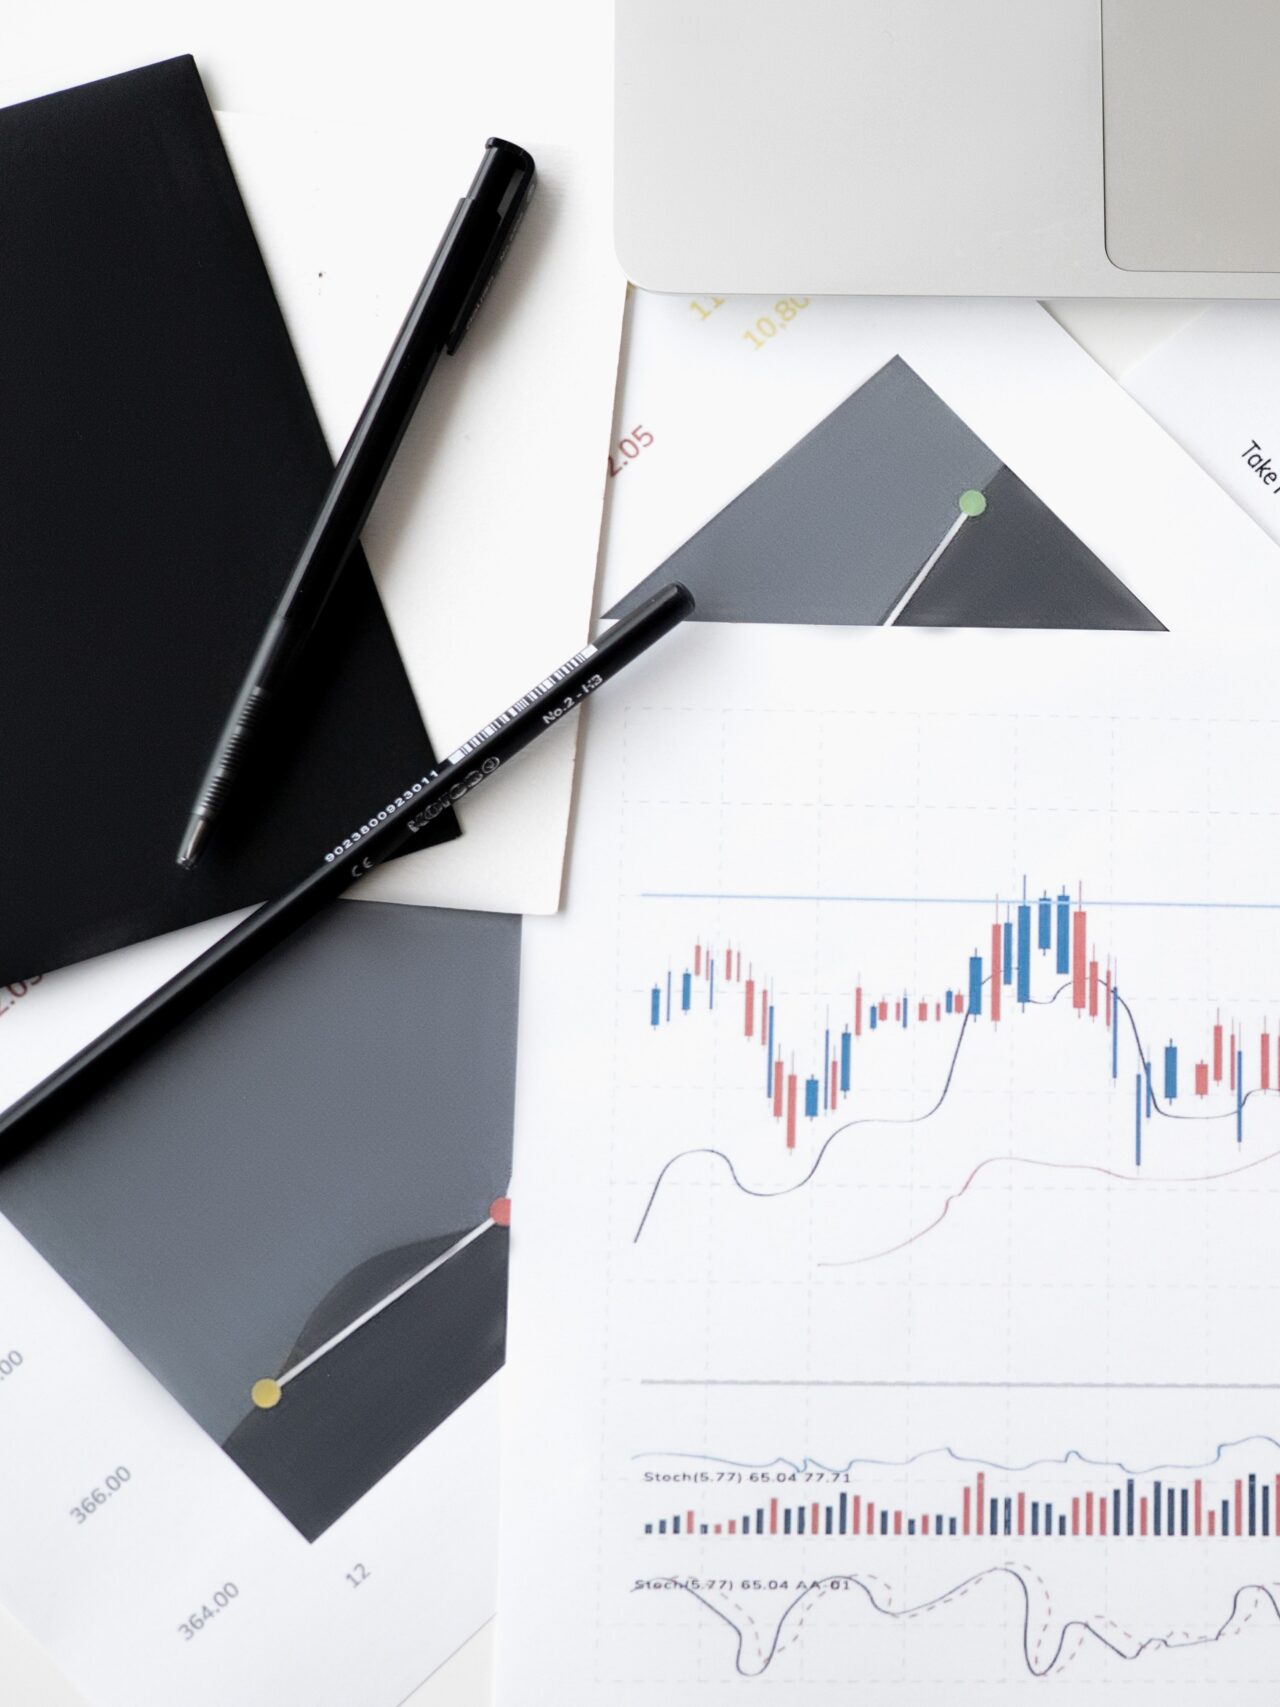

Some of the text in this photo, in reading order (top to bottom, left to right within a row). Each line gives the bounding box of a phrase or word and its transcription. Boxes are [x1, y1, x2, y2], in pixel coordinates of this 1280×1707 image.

[1241, 439, 1278, 485] Take
[543, 697, 575, 724] No.2
[324, 770, 440, 862] 9023800923011
[69, 1466, 131, 1524] 366.00
[750, 1472, 797, 1482] 65.04
[805, 1472, 850, 1483] 77.71
[346, 1563, 371, 1588] 12
[741, 1580, 788, 1590] 65.04
[178, 1582, 239, 1641] 364.00
